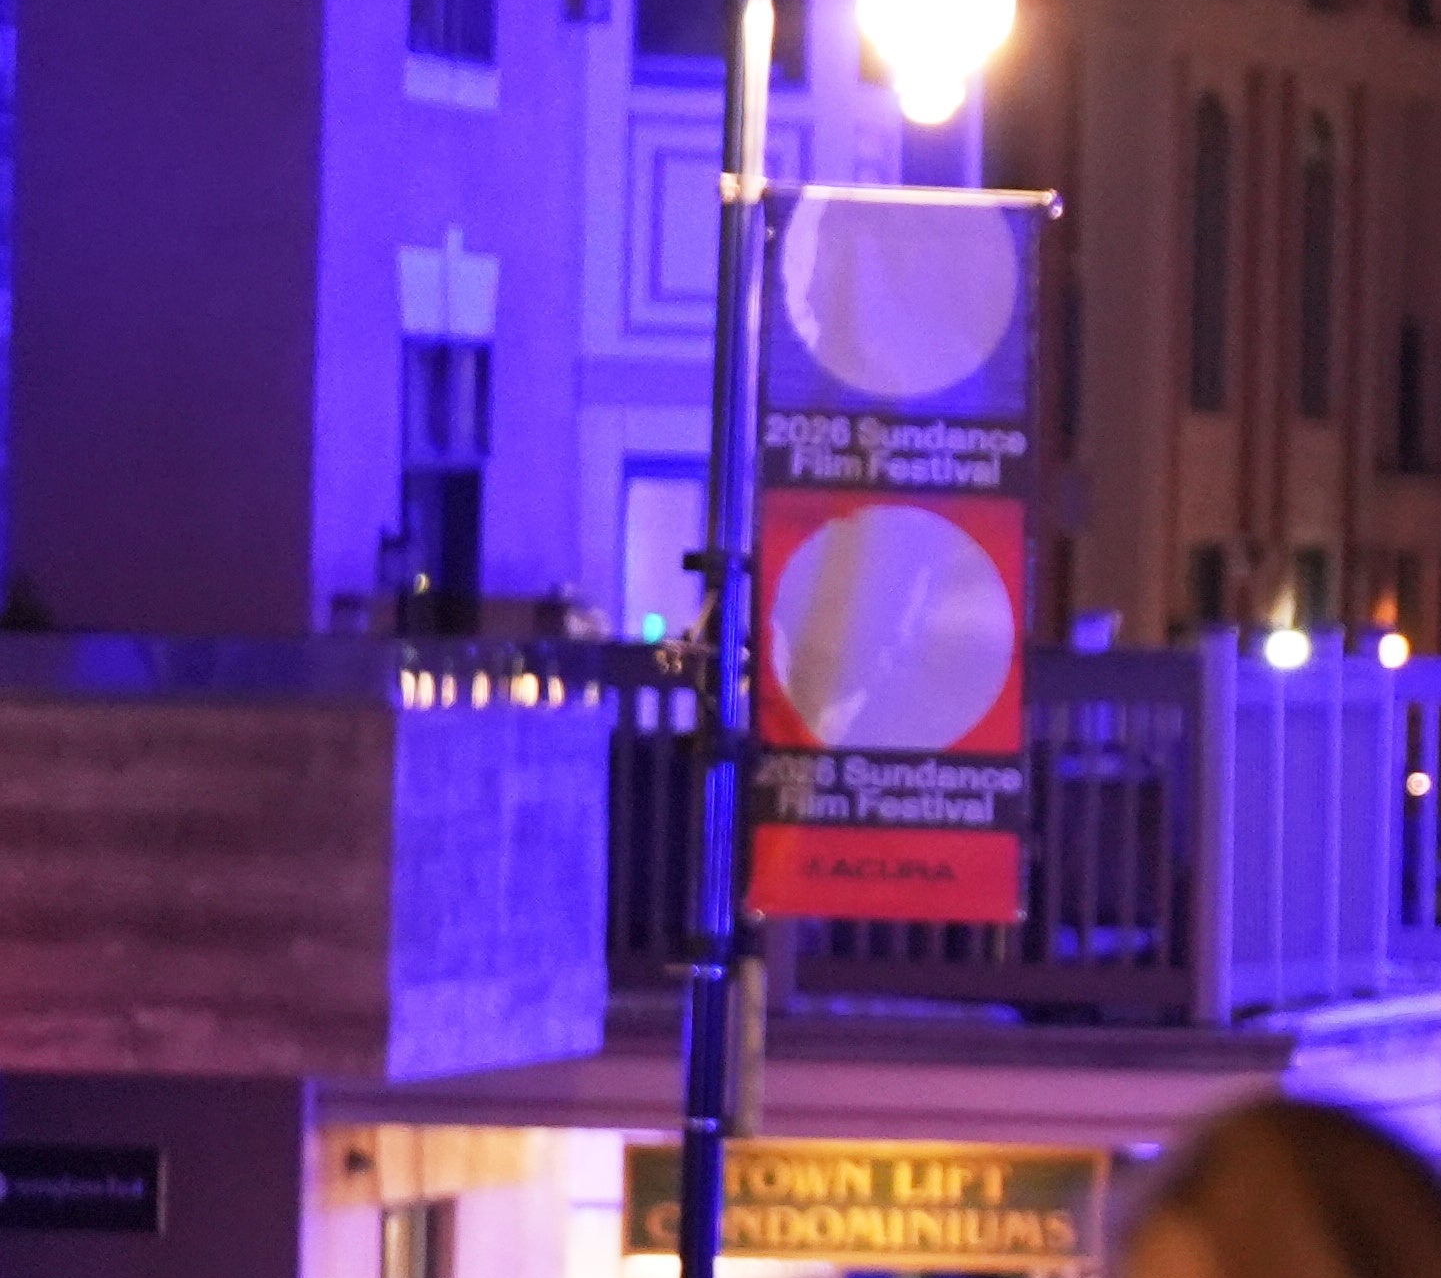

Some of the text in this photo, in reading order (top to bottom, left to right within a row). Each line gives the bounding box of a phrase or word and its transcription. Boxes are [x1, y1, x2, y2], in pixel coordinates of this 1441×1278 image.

[857, 415, 1028, 457] Sundance
[791, 447, 1001, 486] Film Festival
[842, 755, 1024, 794] Sundance
[857, 787, 995, 822] Festival
[723, 1155, 1009, 1203] TOWN LIFT
[645, 1202, 1077, 1249] CNDOMINIUMS
